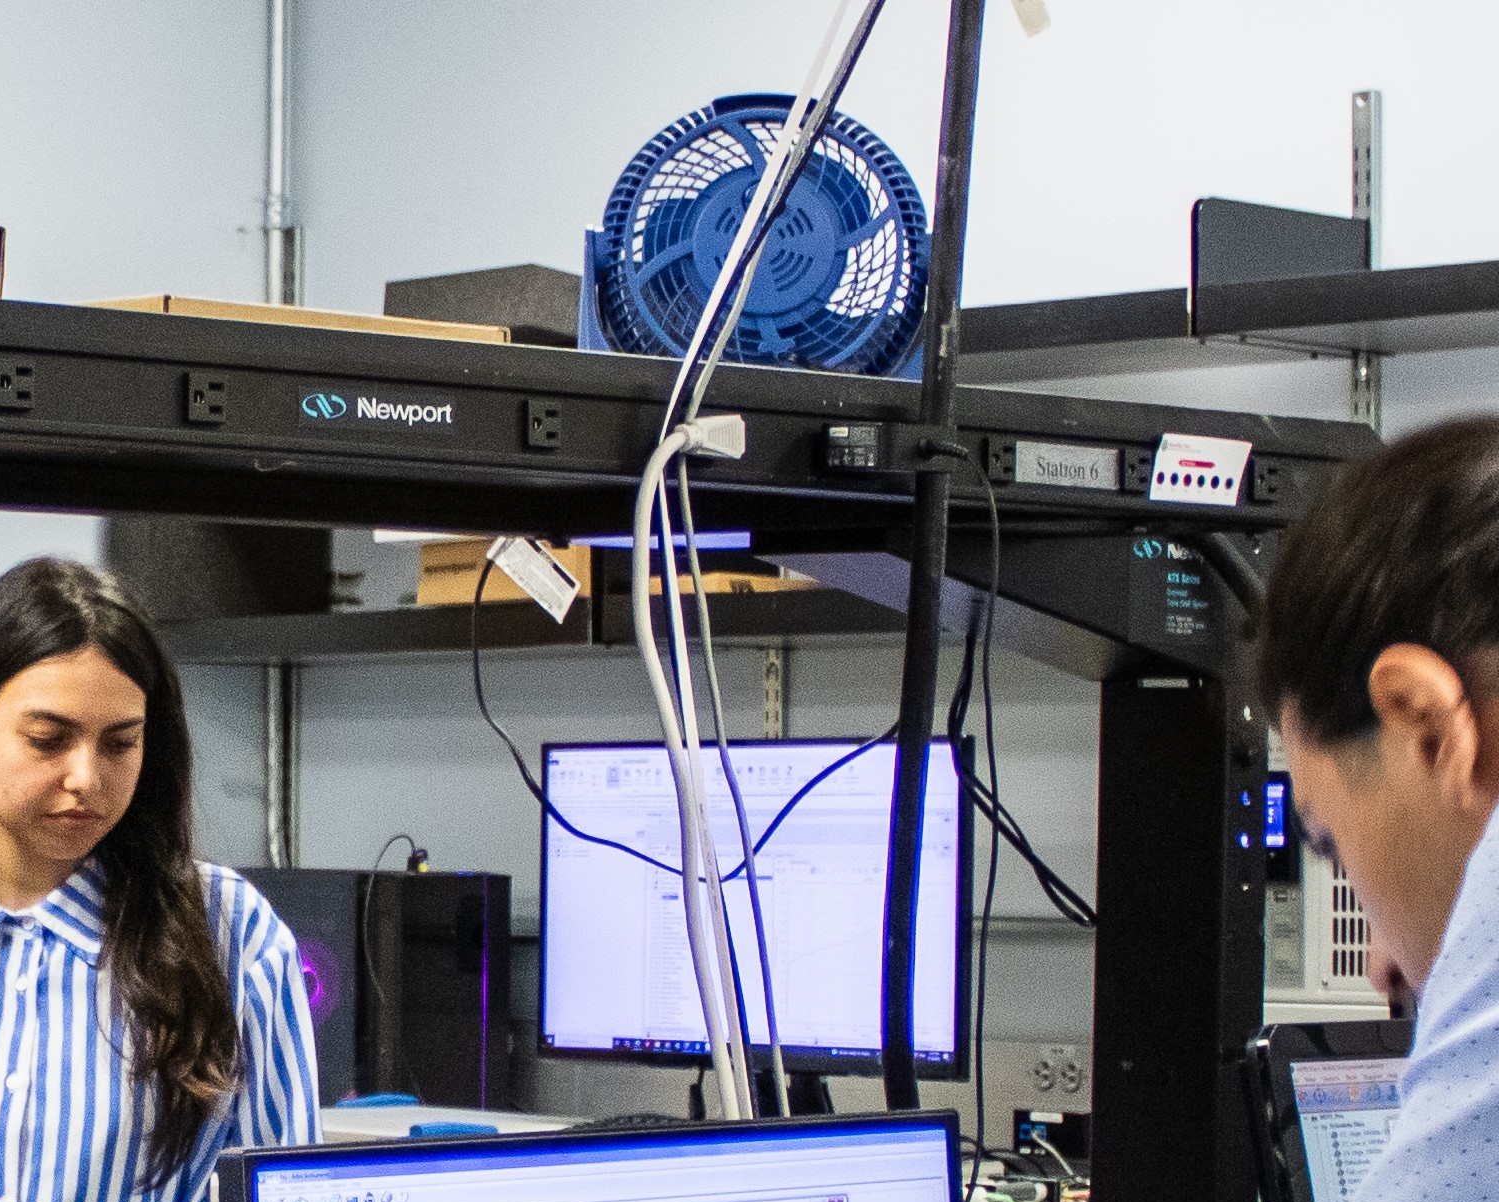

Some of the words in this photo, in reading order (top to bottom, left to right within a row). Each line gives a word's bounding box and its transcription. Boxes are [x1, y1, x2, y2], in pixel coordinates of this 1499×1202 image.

[357, 396, 452, 426] Newport
[1036, 456, 1085, 480] Station
[1090, 463, 1099, 480] 6
